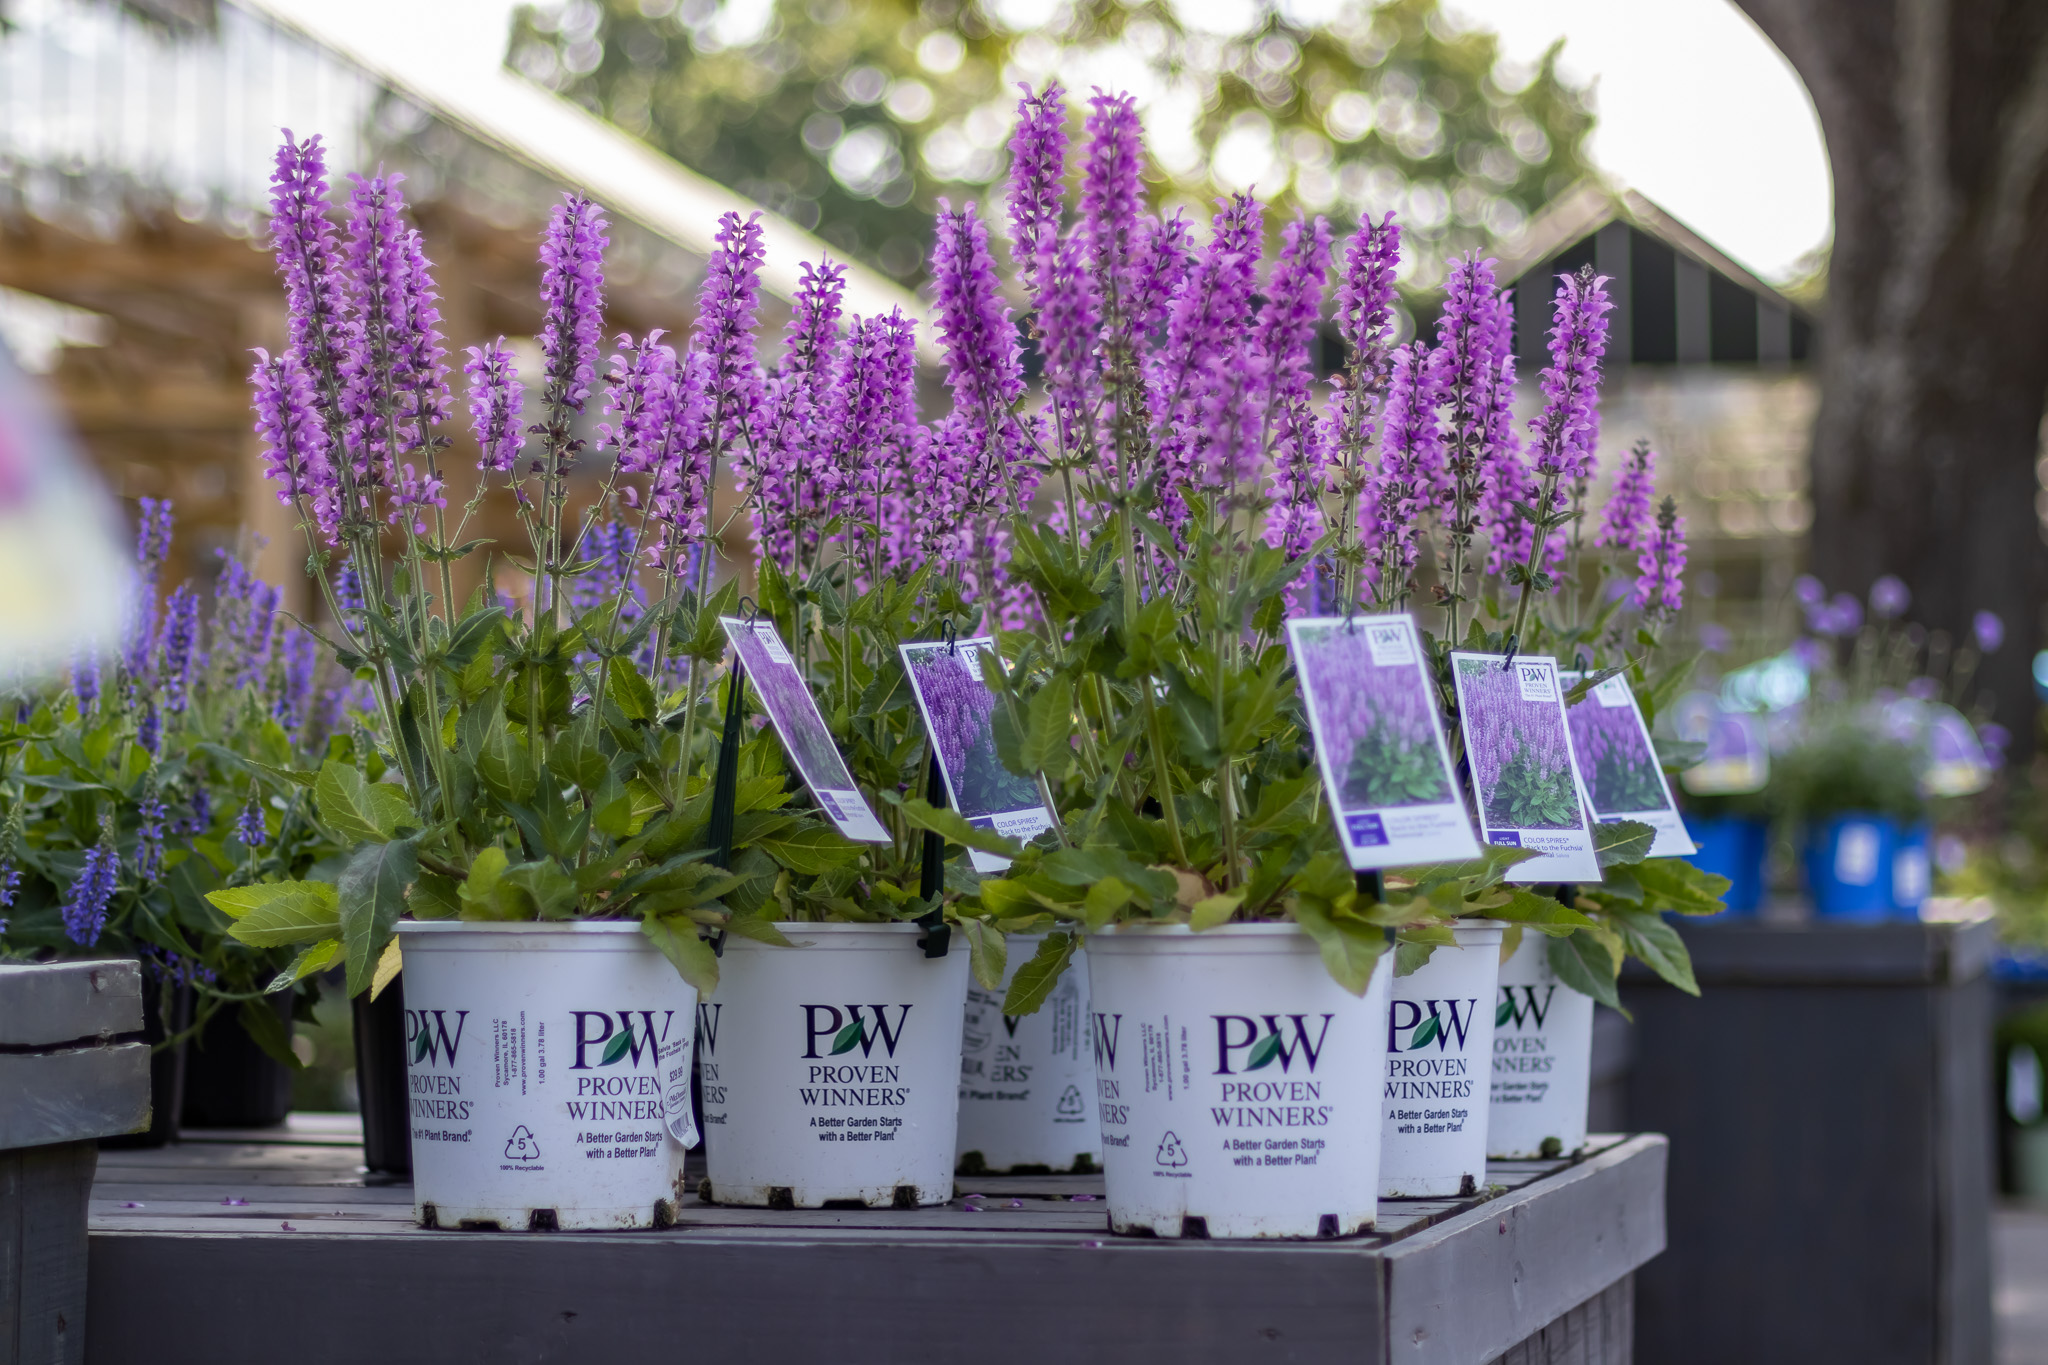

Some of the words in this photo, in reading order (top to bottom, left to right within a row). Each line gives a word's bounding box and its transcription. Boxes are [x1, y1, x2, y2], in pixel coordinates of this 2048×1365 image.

[1521, 668, 1547, 682] PW
[997, 820, 1017, 829] COLOR
[1500, 984, 1557, 1032] W
[799, 1004, 913, 1059] PW
[1387, 999, 1477, 1053] PW
[405, 1010, 470, 1068] PW
[569, 1010, 675, 1070] PW
[1092, 1012, 1123, 1073] W
[1209, 1013, 1335, 1075] PW
[1493, 1036, 1547, 1054] OVEN
[808, 1065, 900, 1084] PROVEN
[1389, 1058, 1467, 1077] PROVEN
[410, 1075, 461, 1095] PROVEN
[576, 1076, 661, 1096] PROVEN
[1221, 1081, 1321, 1102] PROVEN
[1389, 1110, 1396, 1120] A
[1398, 1110, 1422, 1120] Better
[1424, 1109, 1450, 1119] Garden
[1451, 1108, 1468, 1118] Starts
[810, 1117, 817, 1127] A
[818, 1117, 845, 1127] Better
[847, 1116, 878, 1127] Garden
[879, 1116, 902, 1127] Starts
[1398, 1123, 1415, 1134] with
[1417, 1126, 1422, 1134] a
[1424, 1123, 1445, 1133] Better
[425, 1129, 441, 1141] Plant
[577, 1132, 584, 1144] A
[586, 1132, 612, 1144] Better
[614, 1132, 643, 1143] Garden
[644, 1131, 663, 1142] Starts
[818, 1131, 837, 1142] with
[839, 1133, 845, 1142] a
[847, 1131, 872, 1141] Better
[518, 1138, 526, 1150] 5
[1167, 1144, 1175, 1157] 5
[1223, 1139, 1230, 1150] A
[1232, 1139, 1262, 1150] Better
[1264, 1138, 1298, 1150] Garden
[1300, 1138, 1326, 1149] Starts
[586, 1148, 605, 1159] with
[607, 1150, 612, 1158] a
[614, 1147, 638, 1158] Better
[1233, 1155, 1254, 1166] with
[1256, 1157, 1262, 1166] a
[1264, 1155, 1293, 1166] Better
[514, 1164, 544, 1172] Recyclable
